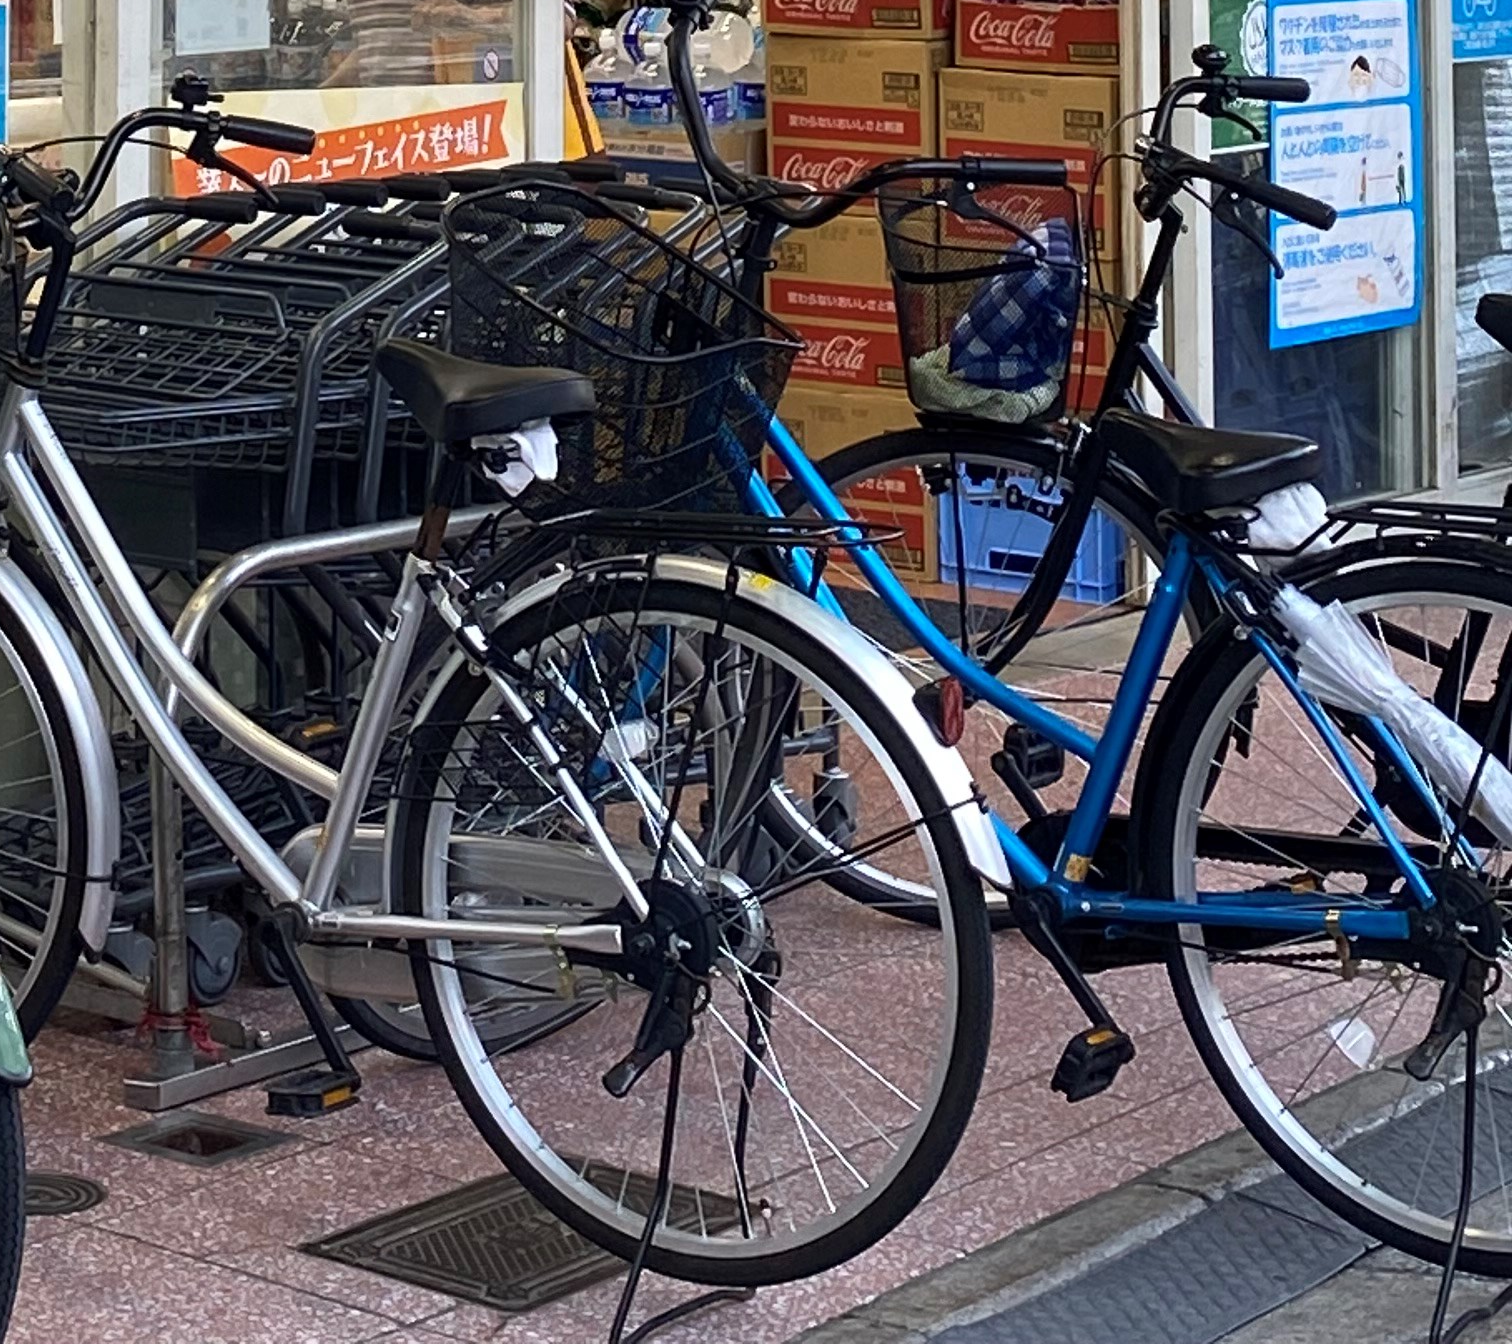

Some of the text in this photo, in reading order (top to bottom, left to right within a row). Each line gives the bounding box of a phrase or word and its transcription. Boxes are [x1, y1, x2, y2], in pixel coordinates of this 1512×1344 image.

[969, 10, 1060, 50] Coca-Cola
[786, 290, 896, 313] 変わらないおいしさと
